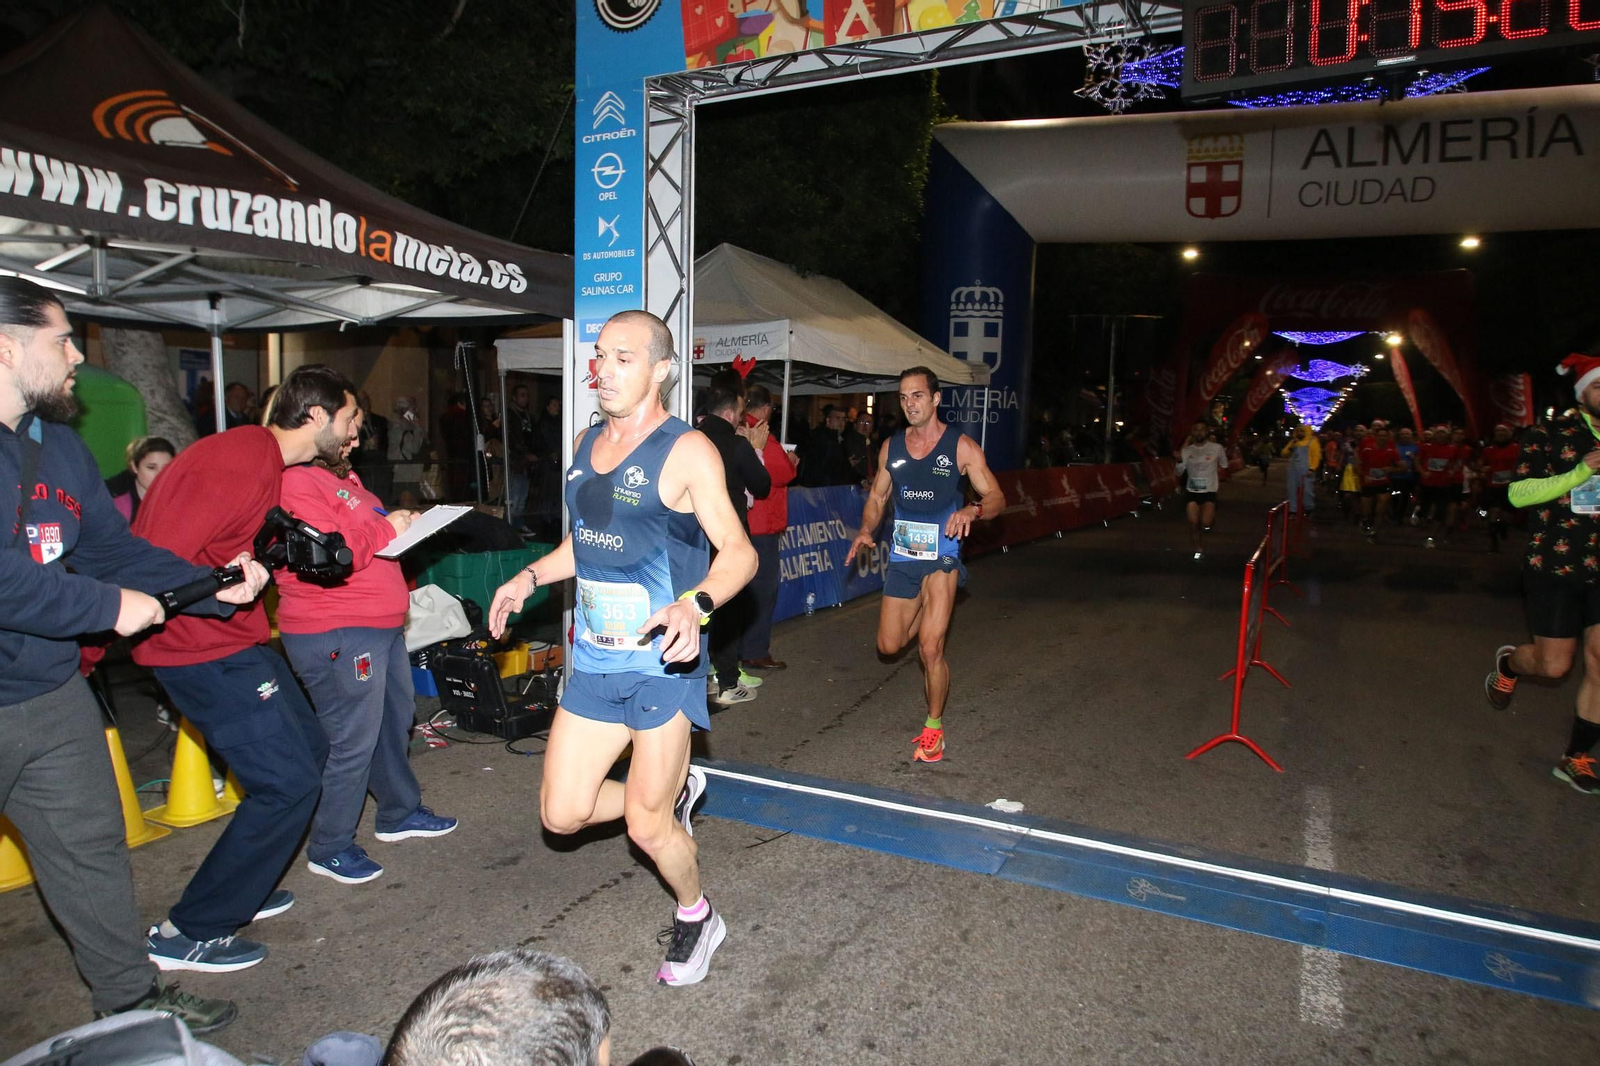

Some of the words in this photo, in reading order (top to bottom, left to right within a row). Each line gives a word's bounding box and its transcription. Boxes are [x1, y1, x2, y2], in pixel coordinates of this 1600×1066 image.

[1301, 106, 1584, 171] ALMERÍA
[598, 191, 618, 201] OPEL
[1298, 175, 1437, 208] CIUDAD
[583, 252, 591, 260] DS
[593, 249, 635, 259] AUTOMOBILES
[594, 271, 622, 282] GRUPO
[581, 285, 615, 296] SALINAS
[616, 284, 634, 294] CAR
[1258, 281, 1393, 319] Coca-Cola
[715, 332, 769, 347] ALMERÍA
[715, 348, 742, 357] CIUDAD
[939, 386, 1019, 410] LMERÍA
[946, 410, 999, 424] CIUDAD
[904, 490, 934, 498] DEHARO
[40, 526, 60, 543] 1890
[578, 528, 624, 548] DEHARO
[778, 519, 847, 551] NTAMIENTO
[908, 532, 935, 544] 1438
[780, 545, 834, 582] ALMERÍA
[602, 602, 638, 621] 363
